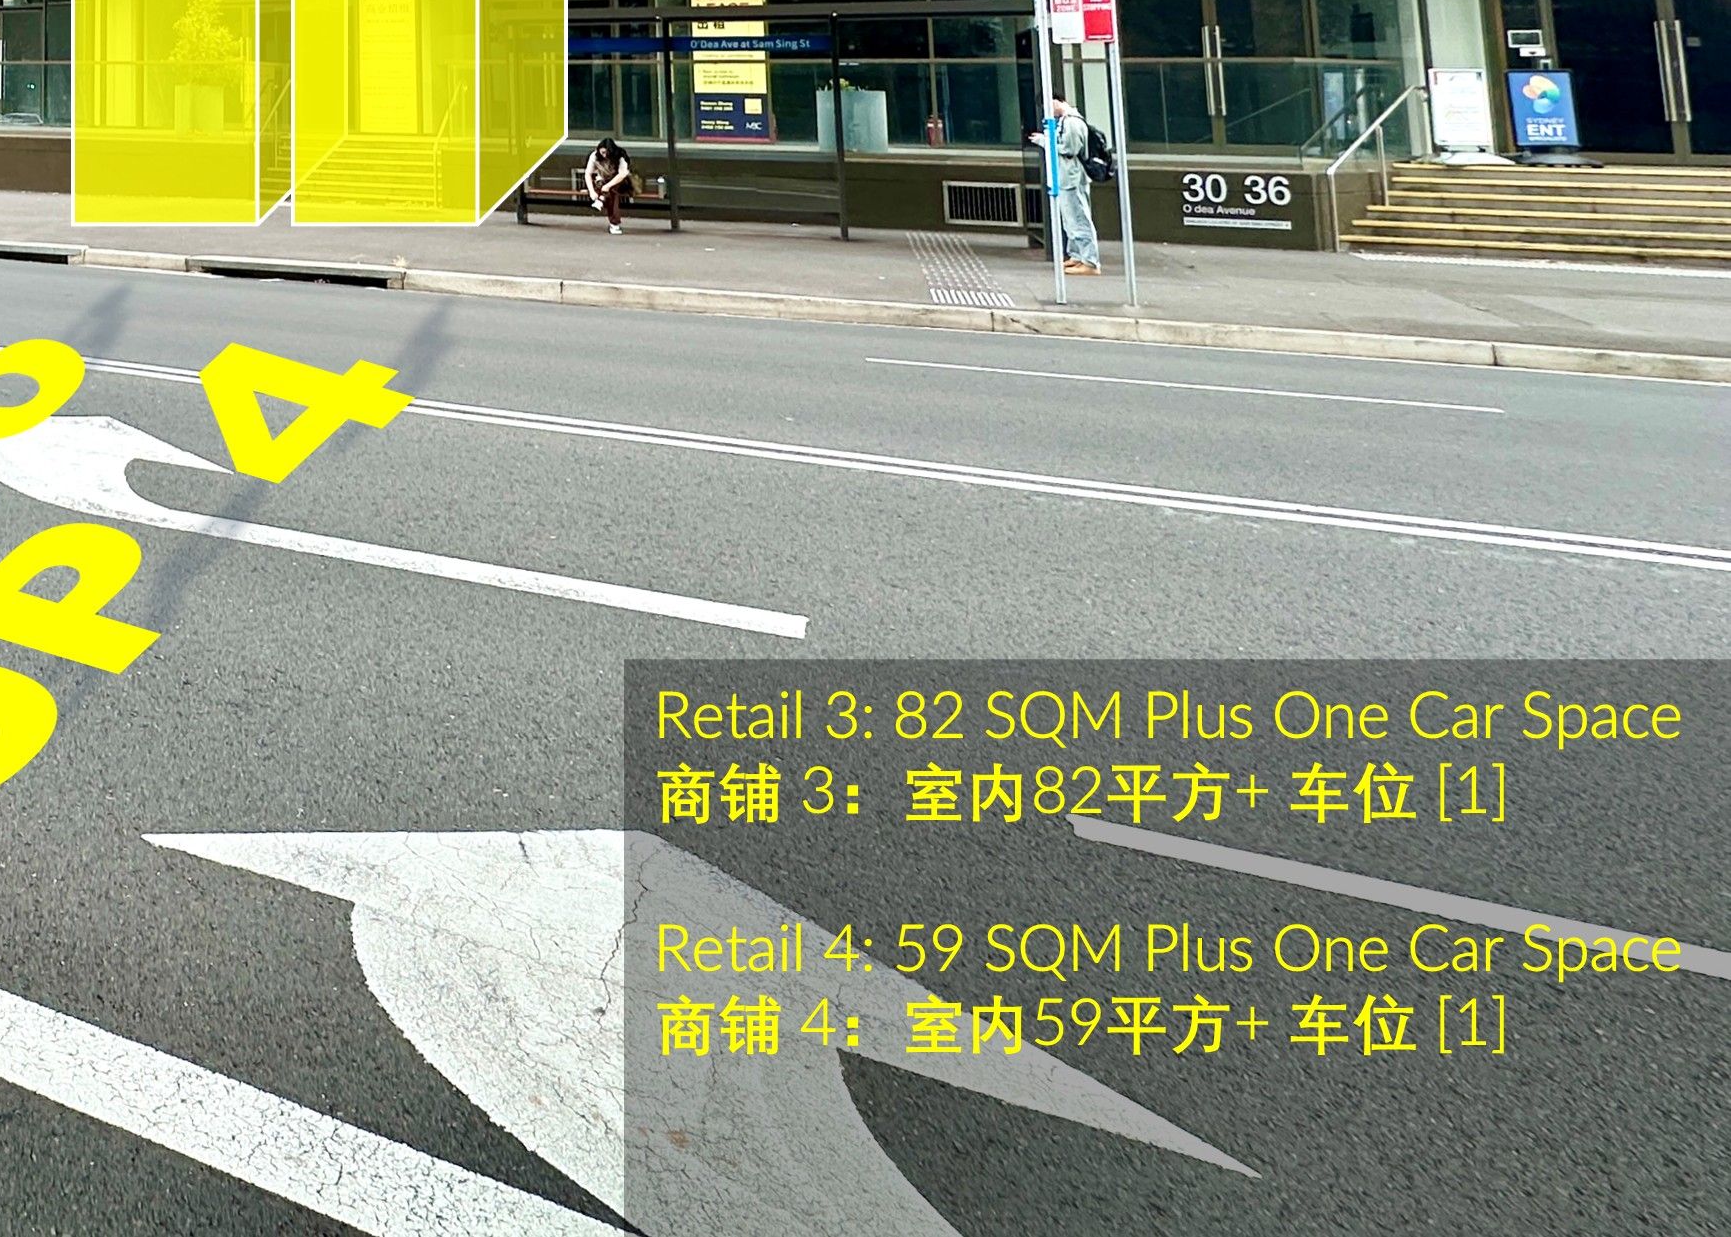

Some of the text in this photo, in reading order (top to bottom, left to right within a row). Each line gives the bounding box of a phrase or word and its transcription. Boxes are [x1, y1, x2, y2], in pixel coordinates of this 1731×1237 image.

[690, 37, 811, 50] O'Dea Ave at Sam Sing St
[1526, 123, 1567, 136] ENT
[1182, 173, 1292, 206] 30 36
[1182, 204, 1256, 216] O dea Avenue
